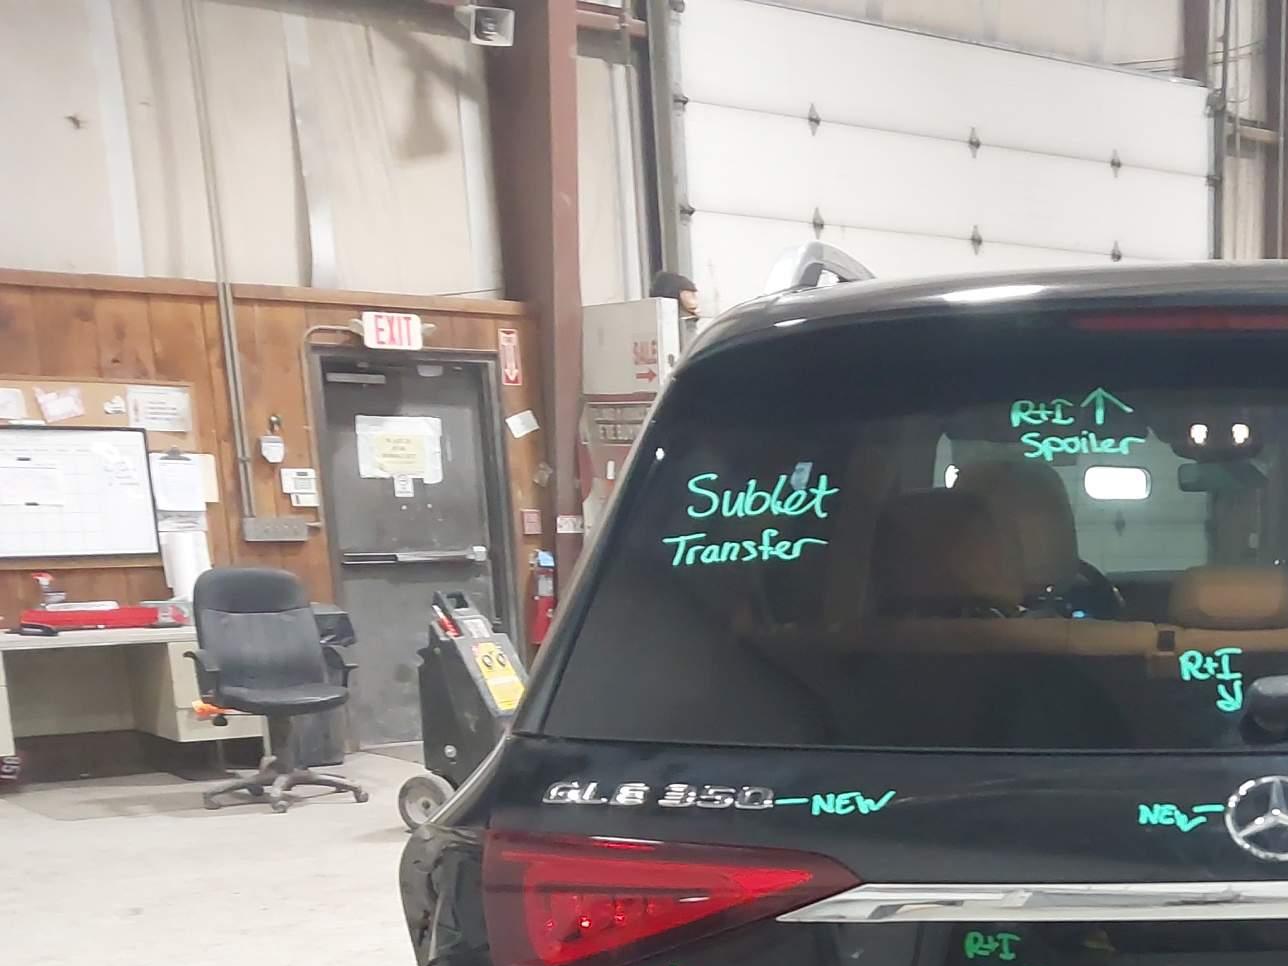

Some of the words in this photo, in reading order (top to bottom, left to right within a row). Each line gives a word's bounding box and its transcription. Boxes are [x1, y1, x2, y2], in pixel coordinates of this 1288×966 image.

[374, 314, 413, 346] EXIT
[1020, 430, 1145, 462] Spoiler
[687, 473, 840, 519] Sublet
[662, 528, 830, 567] Transfer
[1178, 647, 1242, 681] R+I
[658, 782, 774, 810] 350
[811, 790, 896, 816] NEW
[1138, 803, 1208, 832] NEW
